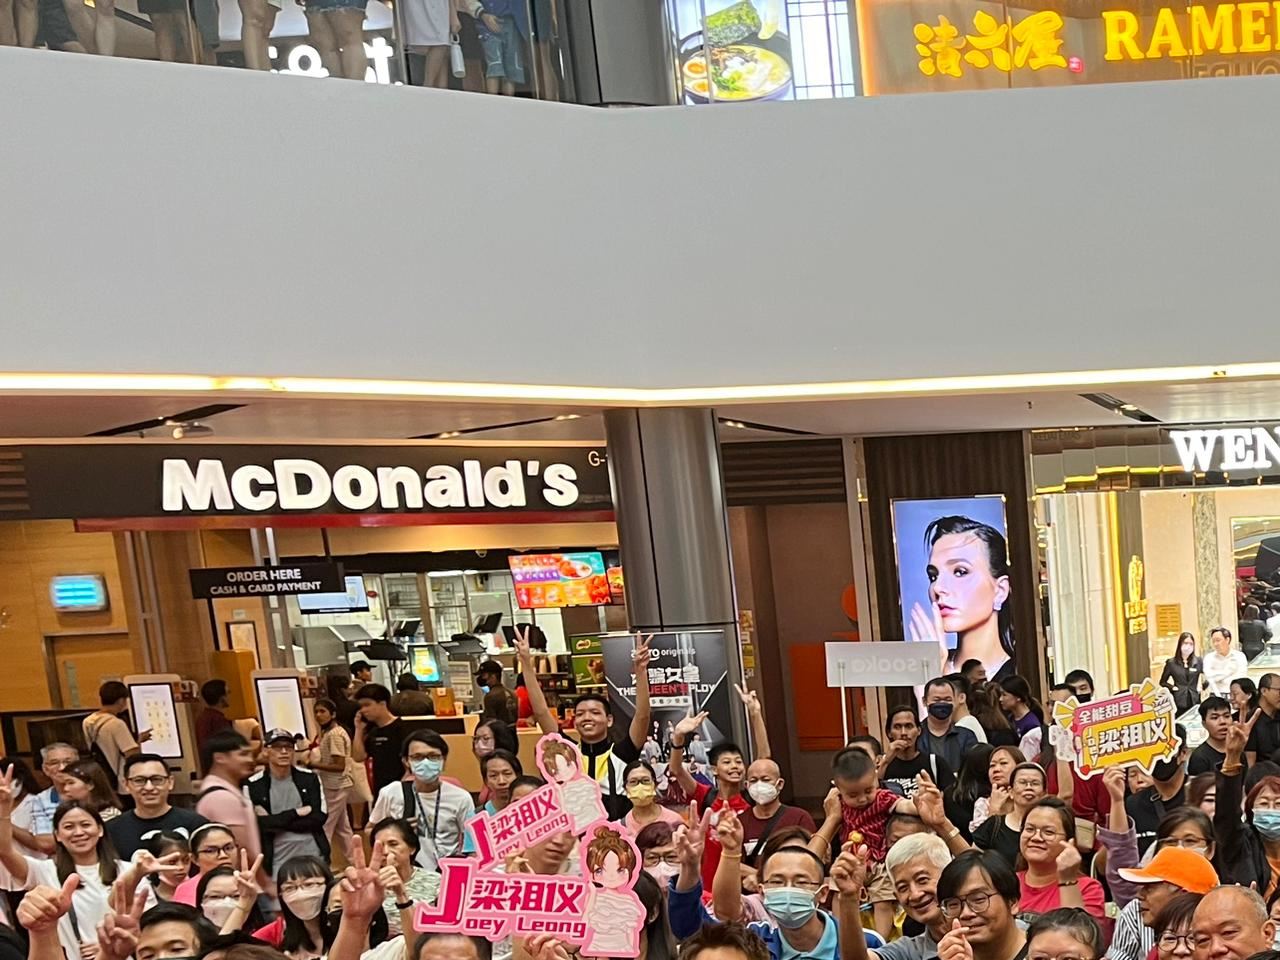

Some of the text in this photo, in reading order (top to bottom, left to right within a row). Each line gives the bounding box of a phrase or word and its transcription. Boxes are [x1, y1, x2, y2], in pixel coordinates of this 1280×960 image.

[162, 459, 579, 512] McDonald's
[210, 581, 322, 594] CASH & CARD PAYMENT
[226, 568, 302, 582] ORDER HERE
[1079, 701, 1133, 724] 全能甜豆
[1098, 716, 1168, 756] 梁祖仪
[491, 788, 558, 845] 梁祖仪
[526, 813, 569, 842] Leong
[471, 879, 583, 914] 梁祖仪
[518, 917, 587, 938] Leong
